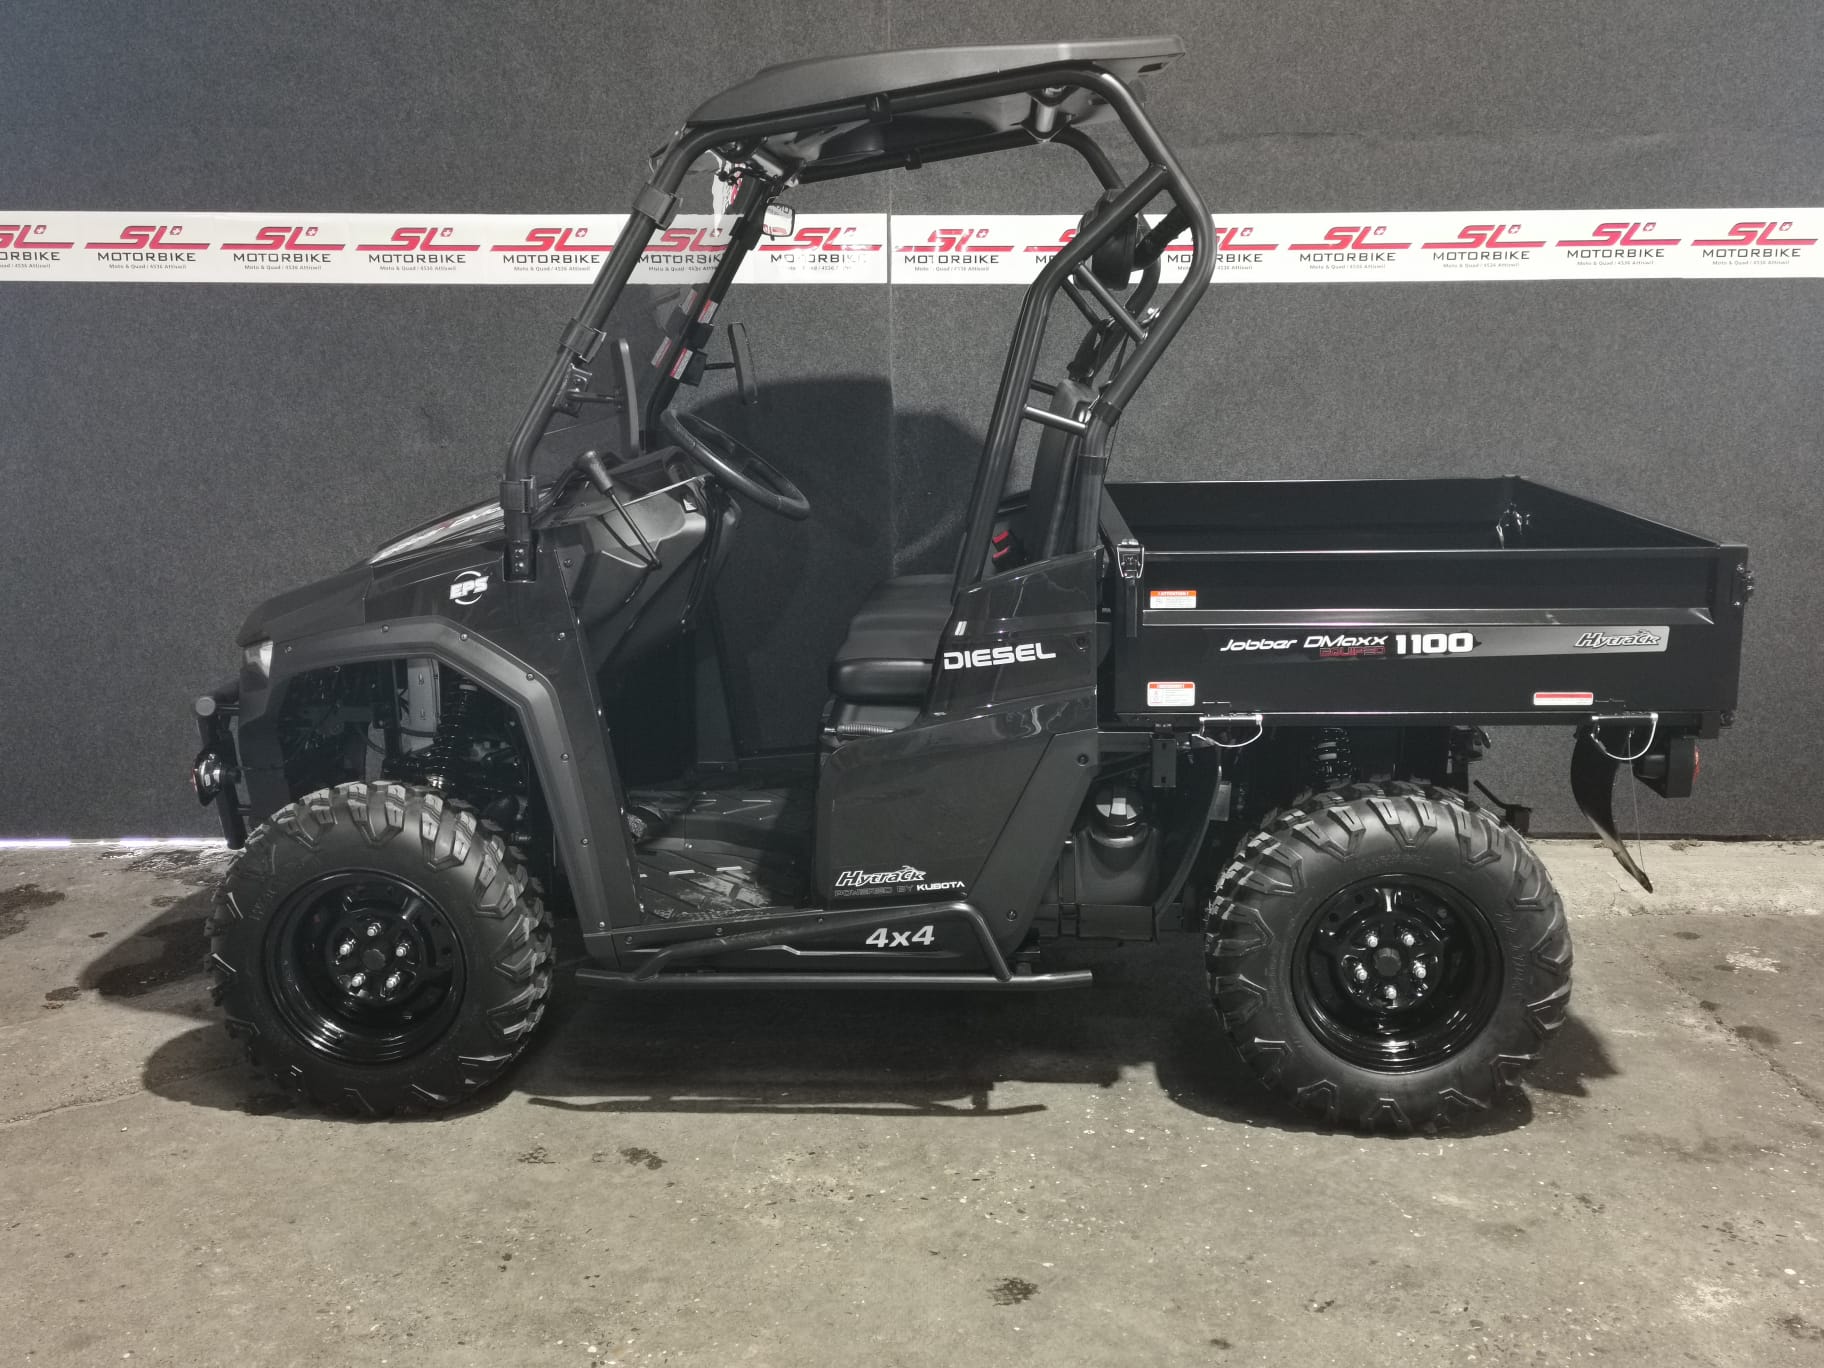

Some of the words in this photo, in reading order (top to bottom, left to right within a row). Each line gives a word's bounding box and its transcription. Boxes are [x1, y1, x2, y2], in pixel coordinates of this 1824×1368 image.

[0, 252, 60, 261] ORBIKE
[98, 252, 196, 262] MOTORBIKE
[233, 253, 331, 263] MOTORBIKE
[1300, 252, 1396, 262] MOTORBIKE
[1433, 250, 1530, 261] MOTORBIKE
[1567, 248, 1665, 259] MOTORBIKE
[1702, 248, 1801, 258] MOTORBIKE
[369, 254, 466, 264] MOTORBIKE
[503, 254, 600, 264] MOTORBIKE
[638, 254, 722, 264] MOTORBIK
[449, 575, 490, 600] EPS
[1220, 638, 1298, 652] Jobber
[1303, 634, 1389, 648] DMaxx
[1395, 632, 1475, 655] 1100
[1573, 630, 1661, 649] Hytrack
[943, 642, 1057, 670] DIESEL
[1319, 646, 1386, 657] EQUIPED
[835, 866, 926, 887] Hytrack
[834, 886, 893, 897] POWERED
[896, 884, 914, 893] BY
[916, 881, 966, 892] KUBOTA
[865, 925, 936, 948] 4x4
